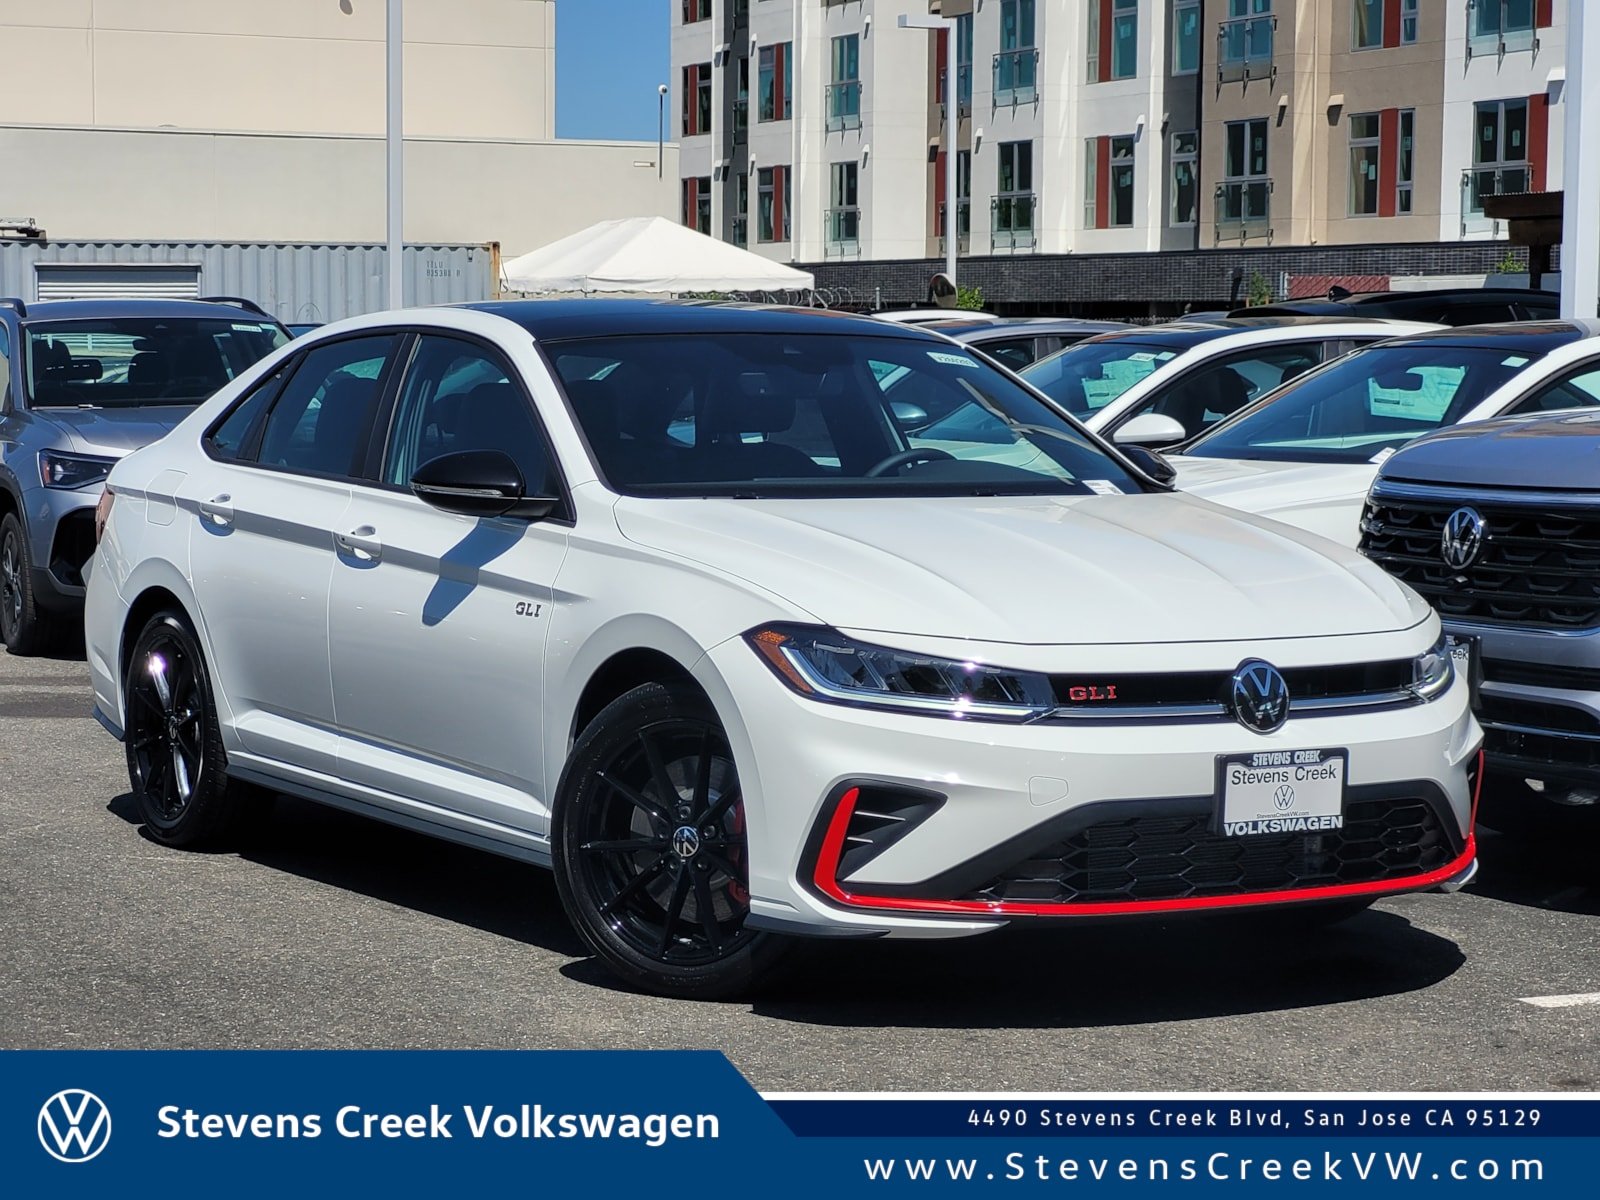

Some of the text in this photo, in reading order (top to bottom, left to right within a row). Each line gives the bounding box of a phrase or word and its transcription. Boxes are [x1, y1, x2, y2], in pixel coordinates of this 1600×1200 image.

[516, 602, 541, 617] GLI
[1452, 647, 1469, 661] eek
[1069, 685, 1118, 701] GLI
[1252, 750, 1321, 767] STEVENS CREEK
[1231, 764, 1337, 785] Stevens Creek
[1256, 811, 1310, 819] StevensCreekVW.com
[1224, 816, 1343, 837] VOLKSWAGEN
